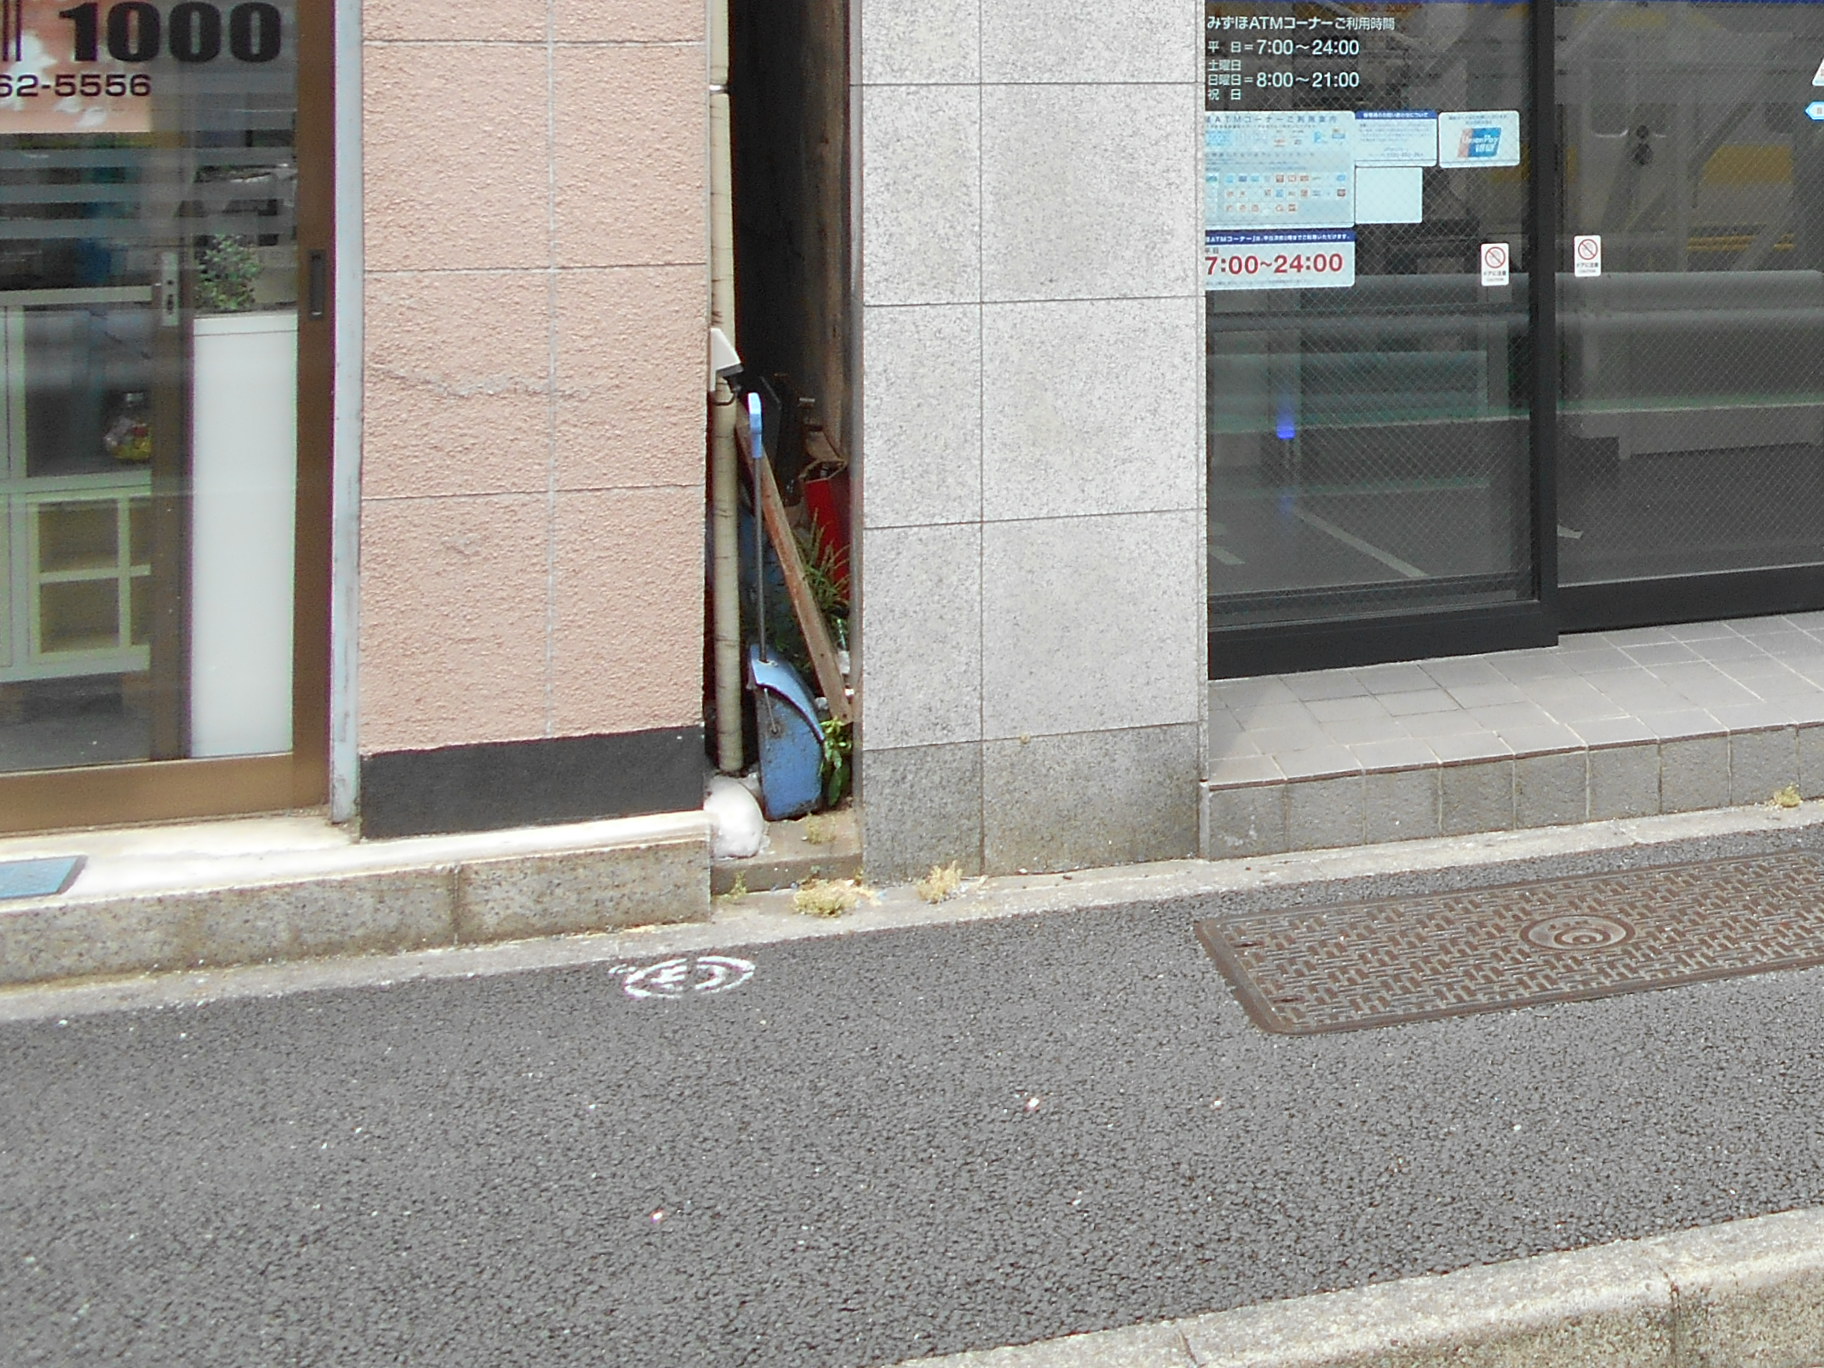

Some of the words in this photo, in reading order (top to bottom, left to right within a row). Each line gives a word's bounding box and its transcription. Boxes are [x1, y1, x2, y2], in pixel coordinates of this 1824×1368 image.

[1206, 15, 1396, 31] みずほATMコーナーご利用時間
[58, 1, 282, 63] 1000
[1207, 59, 1242, 72] 土曜日
